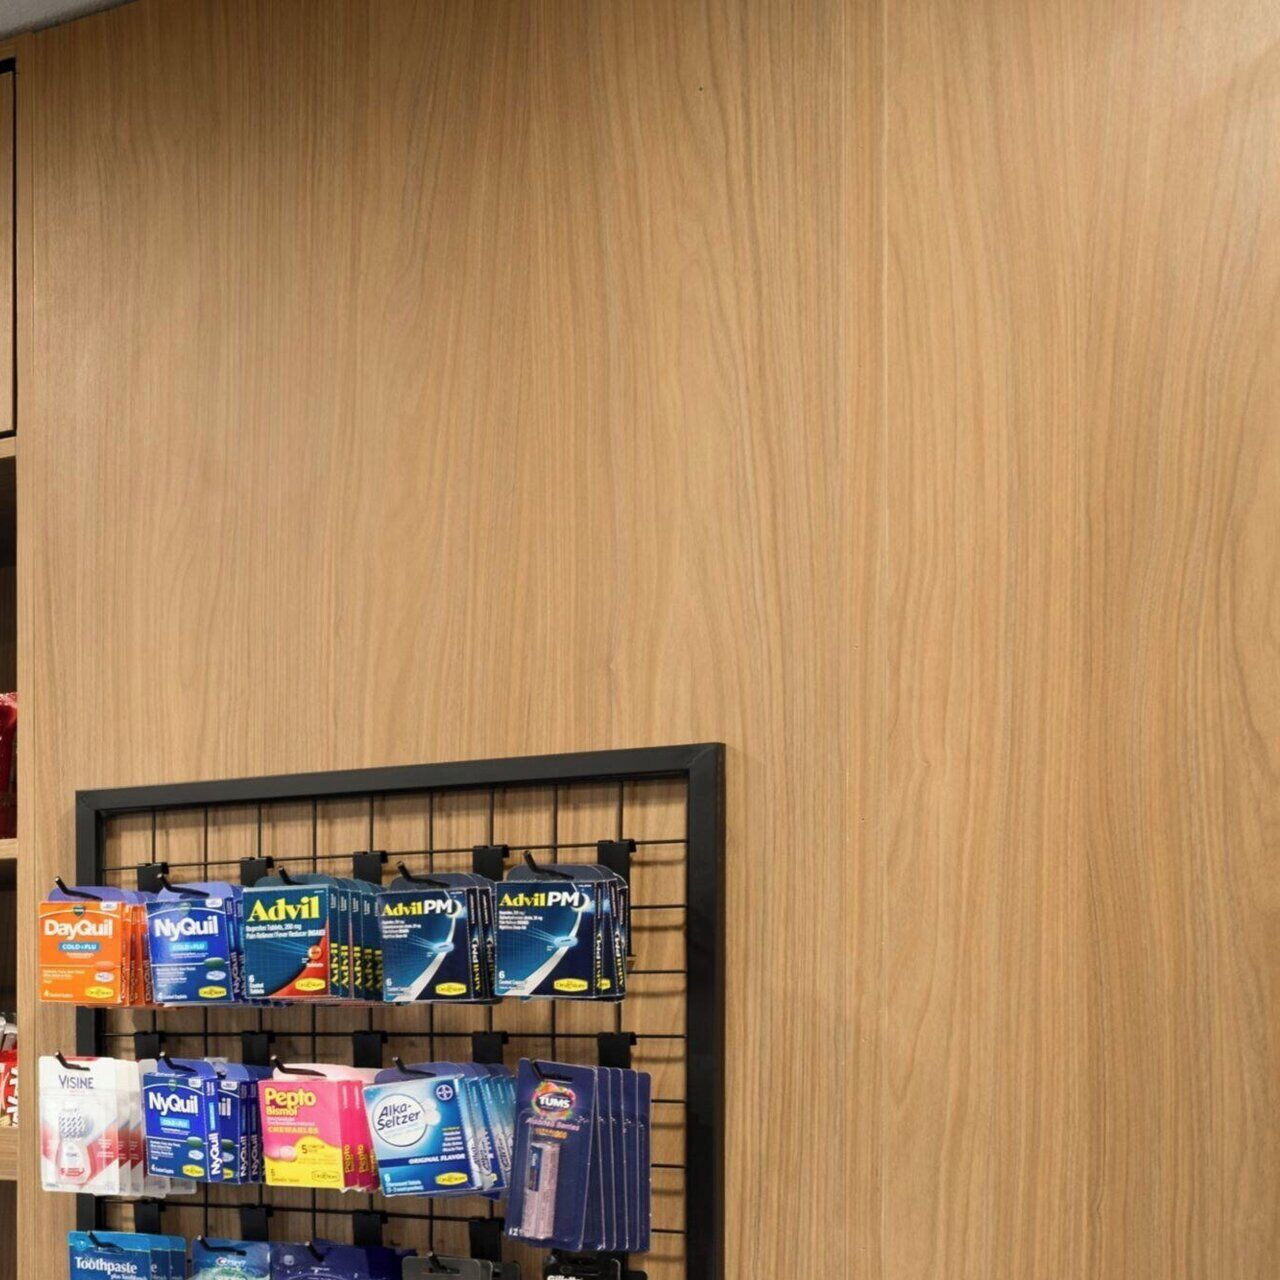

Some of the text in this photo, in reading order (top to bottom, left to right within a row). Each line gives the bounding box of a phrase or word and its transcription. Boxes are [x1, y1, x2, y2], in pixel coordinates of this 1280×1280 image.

[246, 895, 321, 922] Advil
[382, 899, 453, 917] Advil PM
[498, 891, 580, 907] Advil PM
[44, 918, 114, 941] DayQuil
[153, 915, 218, 942] NyQuil
[58, 1075, 95, 1090] VISINE
[148, 1091, 199, 1116] NyQuil
[264, 1087, 317, 1108] Pepto
[538, 1096, 571, 1109] TUMS
[265, 1105, 299, 1117] Bismol
[377, 1110, 422, 1131] Seltzer
[378, 1103, 412, 1119] Alka-
[208, 1132, 223, 1175] NyQuil
[74, 1256, 139, 1275] Toothpaste
